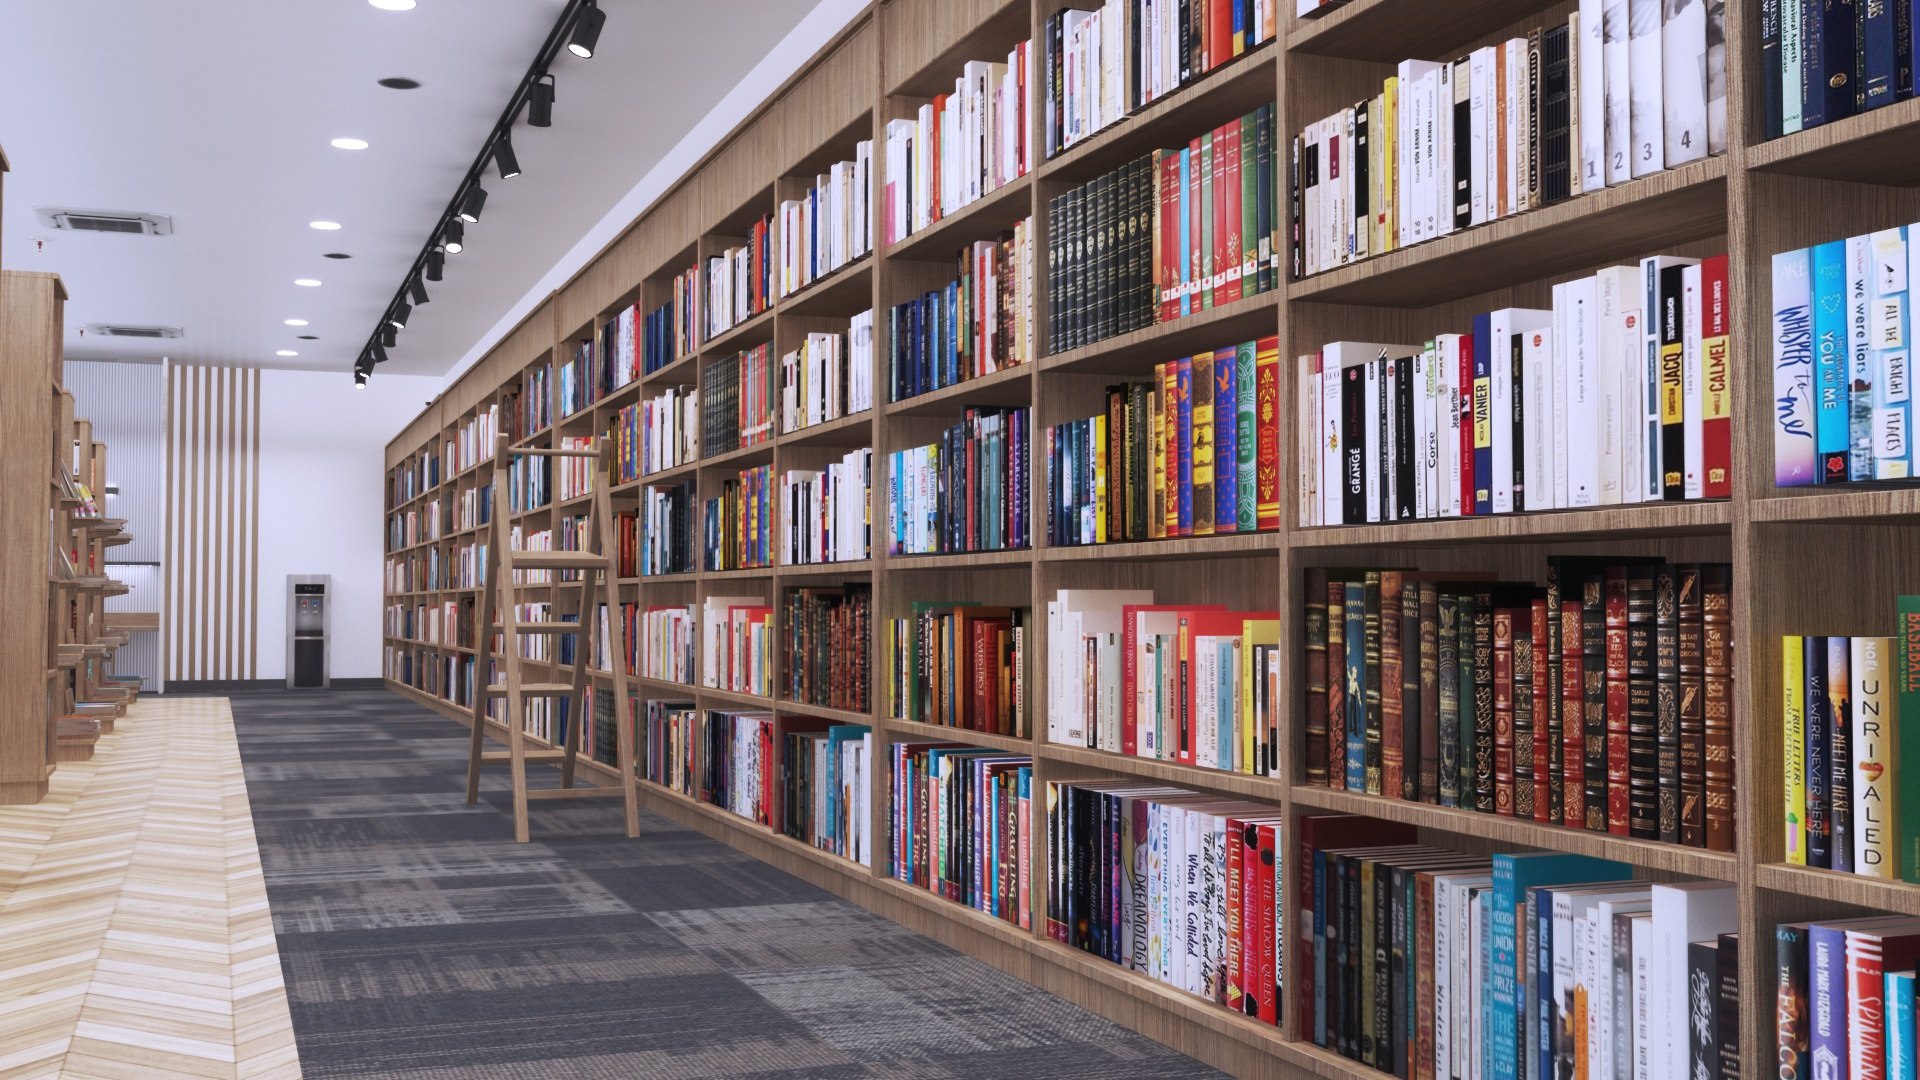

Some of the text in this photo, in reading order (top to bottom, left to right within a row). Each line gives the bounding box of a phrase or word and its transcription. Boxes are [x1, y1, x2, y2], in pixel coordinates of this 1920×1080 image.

[1643, 143, 1652, 160] 3
[1681, 130, 1691, 149] 4
[1587, 161, 1597, 178] 1
[1614, 152, 1623, 170] 2
[1713, 280, 1721, 301] LOUVES
[1855, 280, 1869, 374] we were liars
[1885, 305, 1898, 343] ALL THE
[1325, 371, 1339, 381] ECO
[1664, 352, 1682, 386] JACQ
[1710, 340, 1725, 392] CALMEL
[1775, 305, 1812, 439] WHISPER to me
[1820, 332, 1836, 409] YOU AND ME
[1889, 358, 1903, 395] BRIGHT
[1450, 387, 1459, 429] Jean Berthier
[1476, 384, 1487, 423] VANIER
[1428, 432, 1436, 468] Corse
[1886, 413, 1901, 451] PLACES
[1350, 448, 1361, 494] GRANGÉ
[1865, 641, 1878, 672] NOËL
[1908, 613, 1920, 691] BASEBALL
[1792, 707, 1801, 786] TRUE LETTERS
[1810, 676, 1822, 838] WE WERE NEVER HERE
[1832, 732, 1848, 813] MEET ME HERE
[1113, 832, 1119, 851] MY
[1203, 847, 1213, 861] all
[1230, 838, 1239, 862] I'LL
[999, 862, 1007, 900] FIRE
[1204, 864, 1214, 883] the
[1230, 868, 1239, 904] MEET
[1301, 842, 1312, 894] JOHN
[1187, 854, 1198, 957] When We Collided
[1217, 887, 1226, 918] still
[1244, 883, 1256, 931] SECRETS
[1377, 879, 1385, 906] JOHN
[1134, 873, 1147, 971] DREAMOLOGY
[1230, 908, 1239, 932] YOU
[1482, 905, 1490, 944] MICHAEL
[1527, 891, 1536, 975] PAUL AUSTER
[1201, 933, 1213, 960] loved
[1216, 927, 1225, 958] love
[1230, 937, 1239, 977] THERE
[1262, 878, 1272, 1007] THE SHADOW QUEEN
[1494, 934, 1514, 952] UNION
[1540, 918, 1548, 974] ORACLE NIGHT
[1816, 942, 1829, 967] LAURA
[1201, 962, 1214, 997] before
[1421, 881, 1431, 1072] MICHAEL CHABON
[1381, 1008, 1387, 1019] TO
[1540, 1000, 1549, 1051] PAUL AUSTER
[1618, 1033, 1624, 1049] OF
